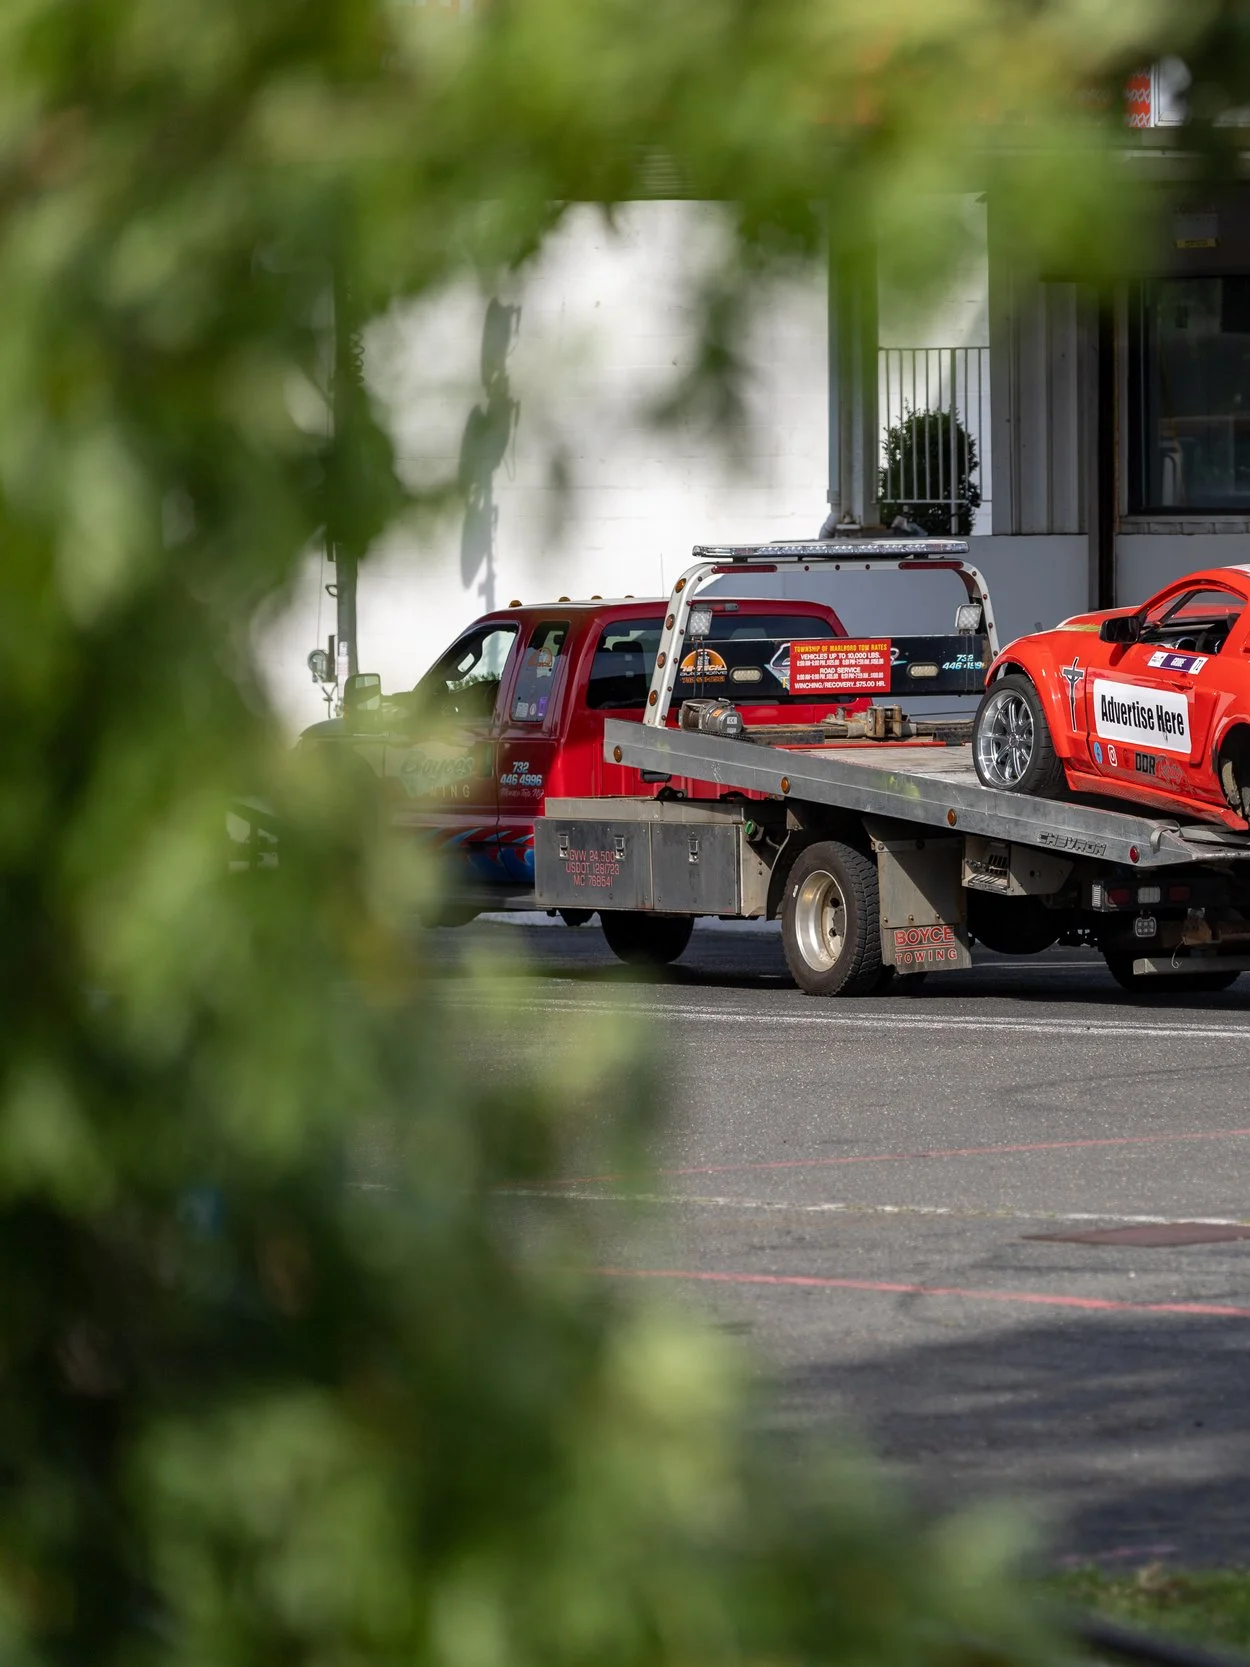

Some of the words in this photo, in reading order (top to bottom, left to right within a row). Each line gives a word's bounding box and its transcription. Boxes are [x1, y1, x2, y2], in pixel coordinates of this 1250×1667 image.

[942, 662, 962, 670] 446
[1101, 694, 1155, 731] Advertise
[1155, 704, 1185, 737] Here
[512, 761, 530, 773] 732
[1134, 751, 1156, 776] DDR
[500, 774, 518, 786] 446
[519, 774, 543, 787] 4996
[894, 926, 955, 946] BOYCE
[895, 948, 958, 965] TOWING
